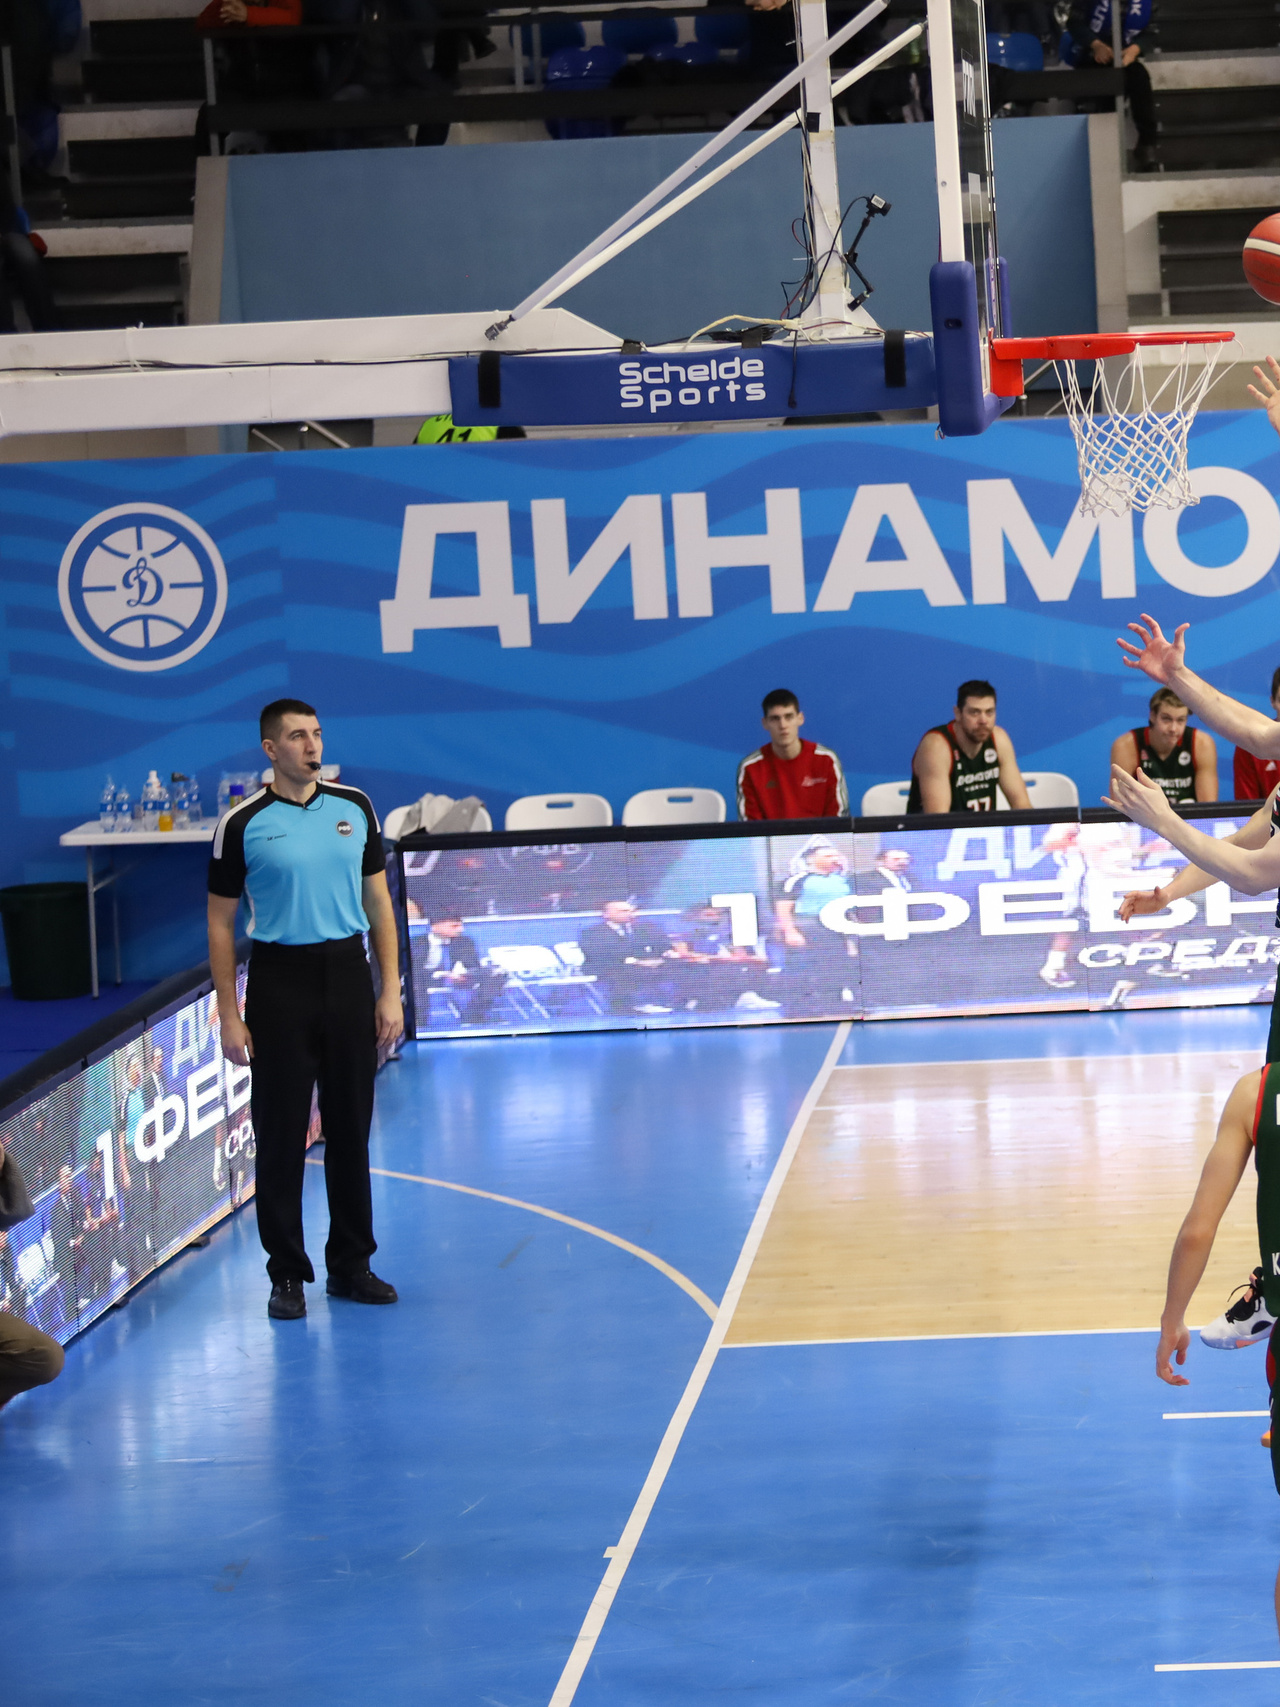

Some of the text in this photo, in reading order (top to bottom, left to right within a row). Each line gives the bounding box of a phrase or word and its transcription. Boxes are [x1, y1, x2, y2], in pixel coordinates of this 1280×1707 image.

[619, 357, 764, 385] Schelde
[620, 381, 766, 413] Sports
[711, 893, 760, 946] 1
[97, 1129, 115, 1200] 1
